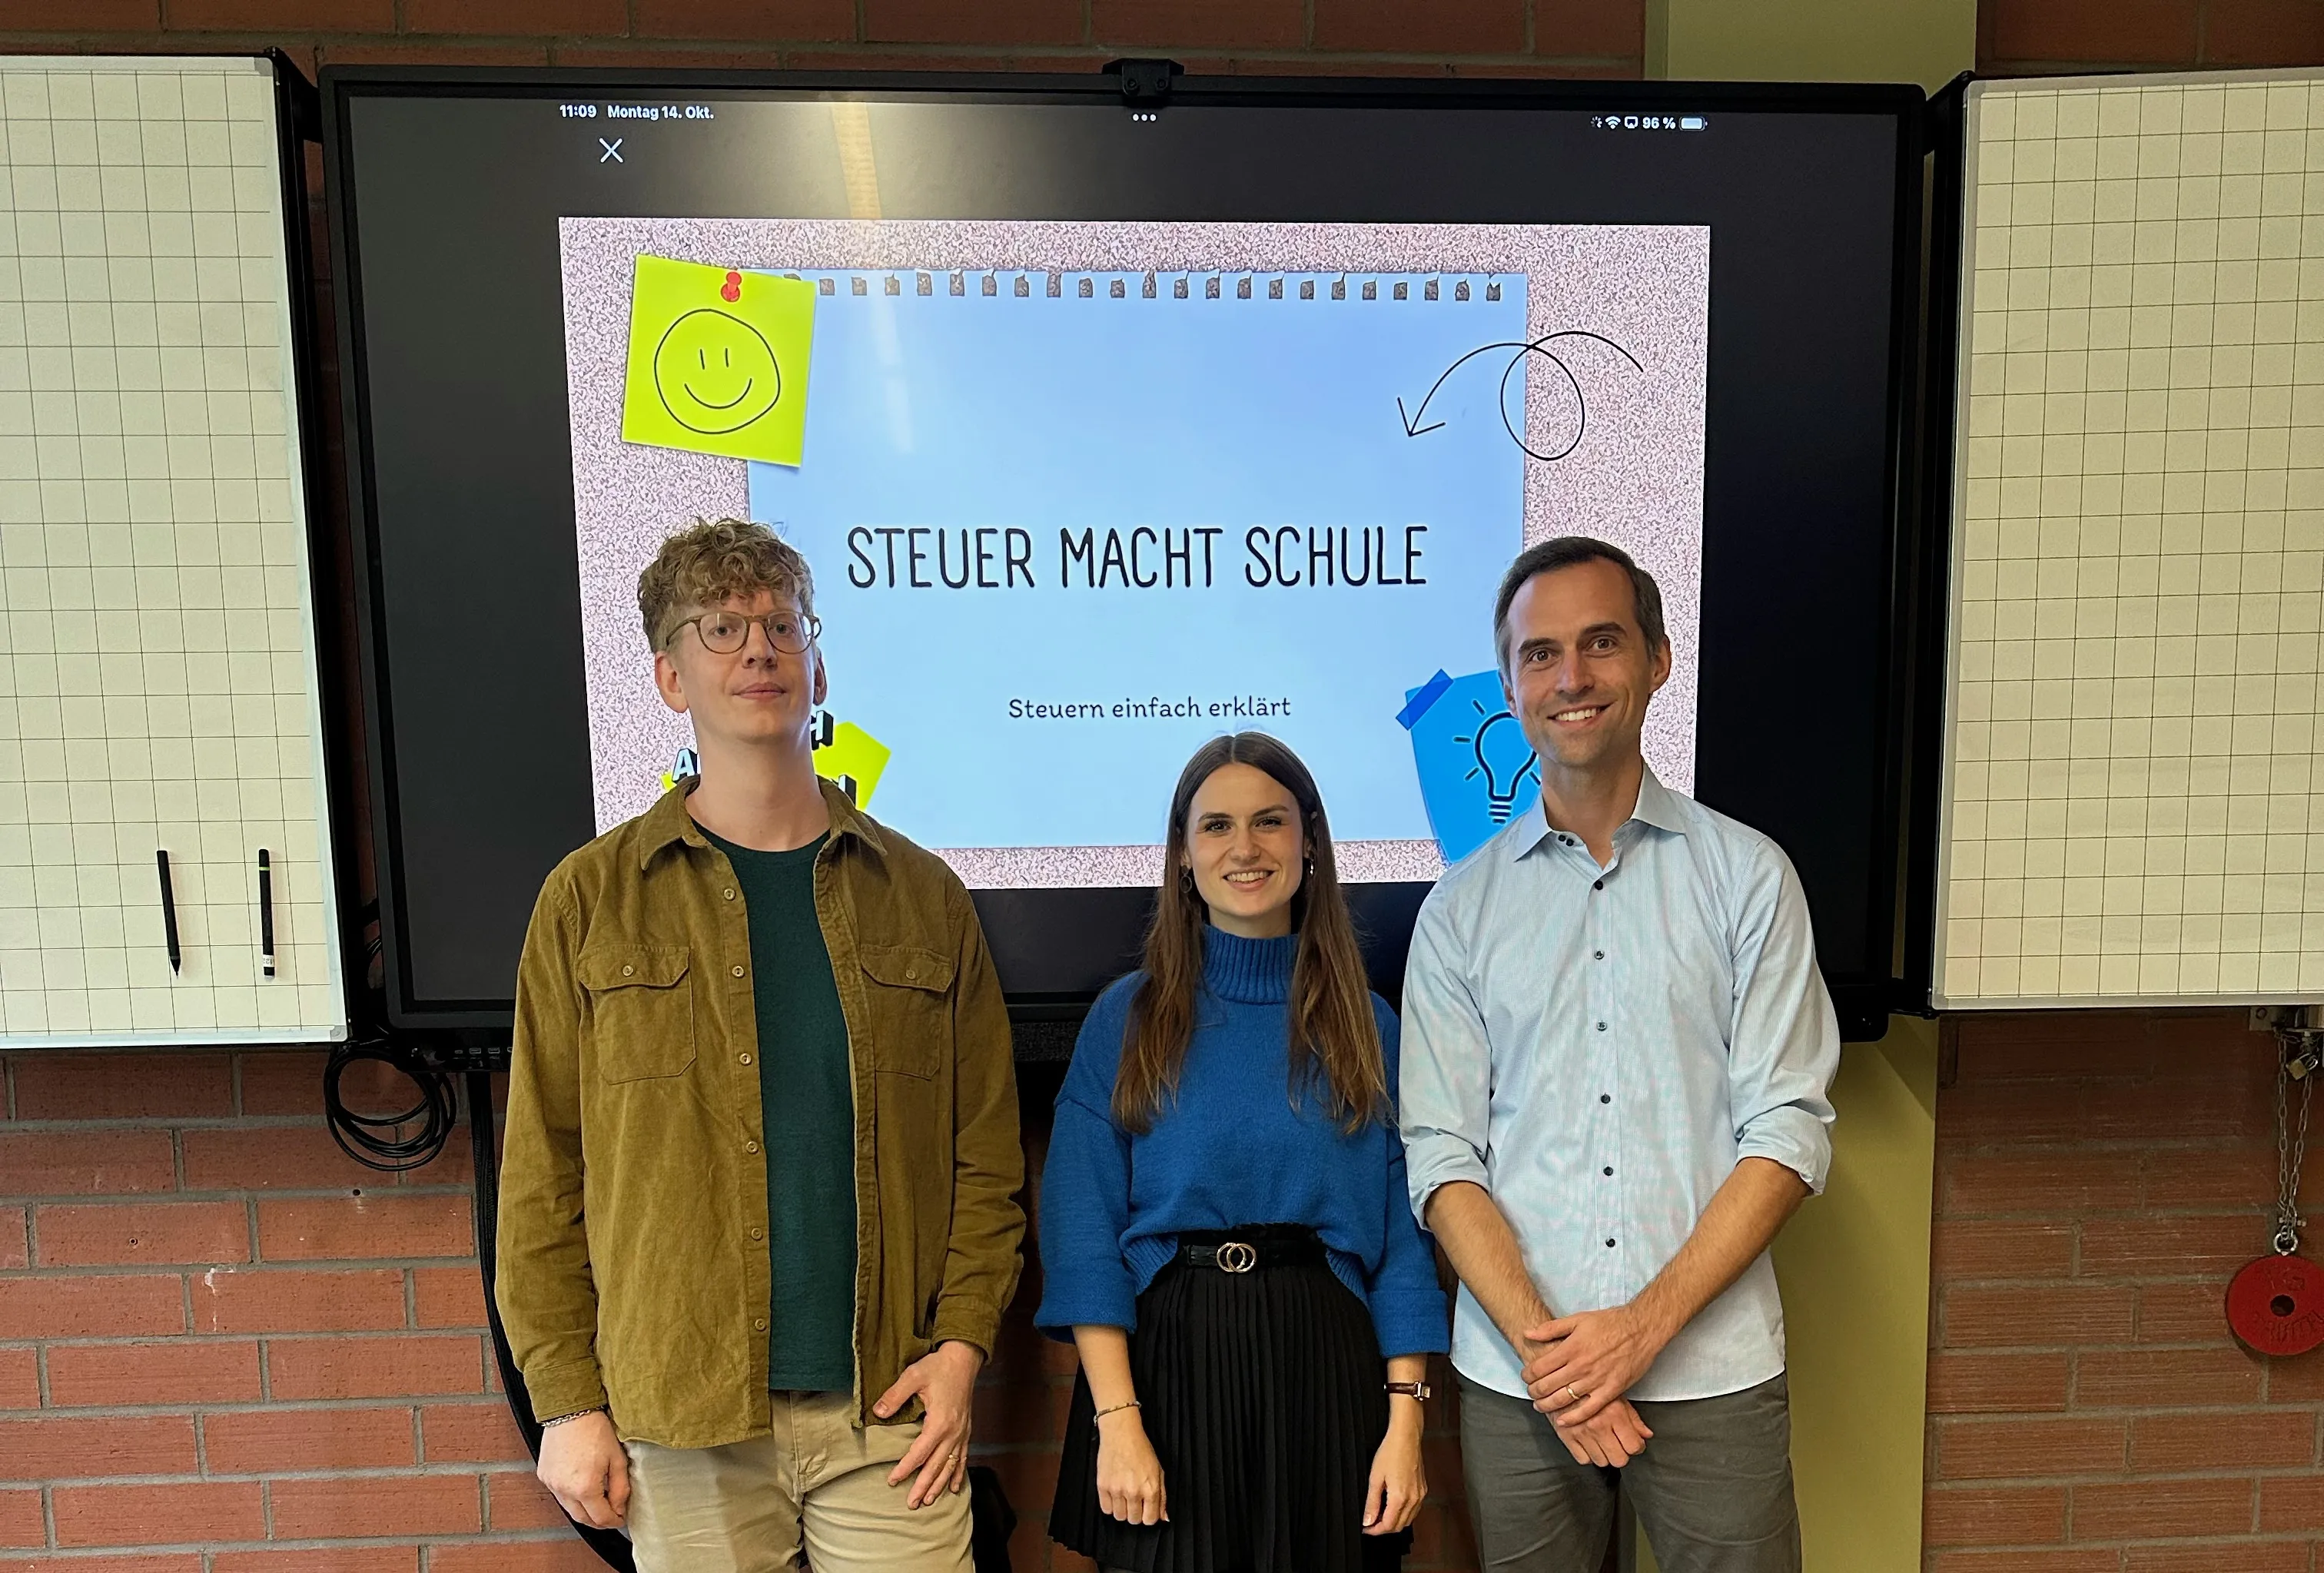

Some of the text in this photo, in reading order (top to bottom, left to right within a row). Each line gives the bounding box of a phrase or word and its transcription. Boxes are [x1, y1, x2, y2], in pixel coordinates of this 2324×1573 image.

[559, 105, 714, 121] 11:09 Montag 14. Okt.
[848, 526, 1428, 589] STEUER MACHT SCHULE
[1008, 695, 1291, 718] Steuern einfach erklärt
